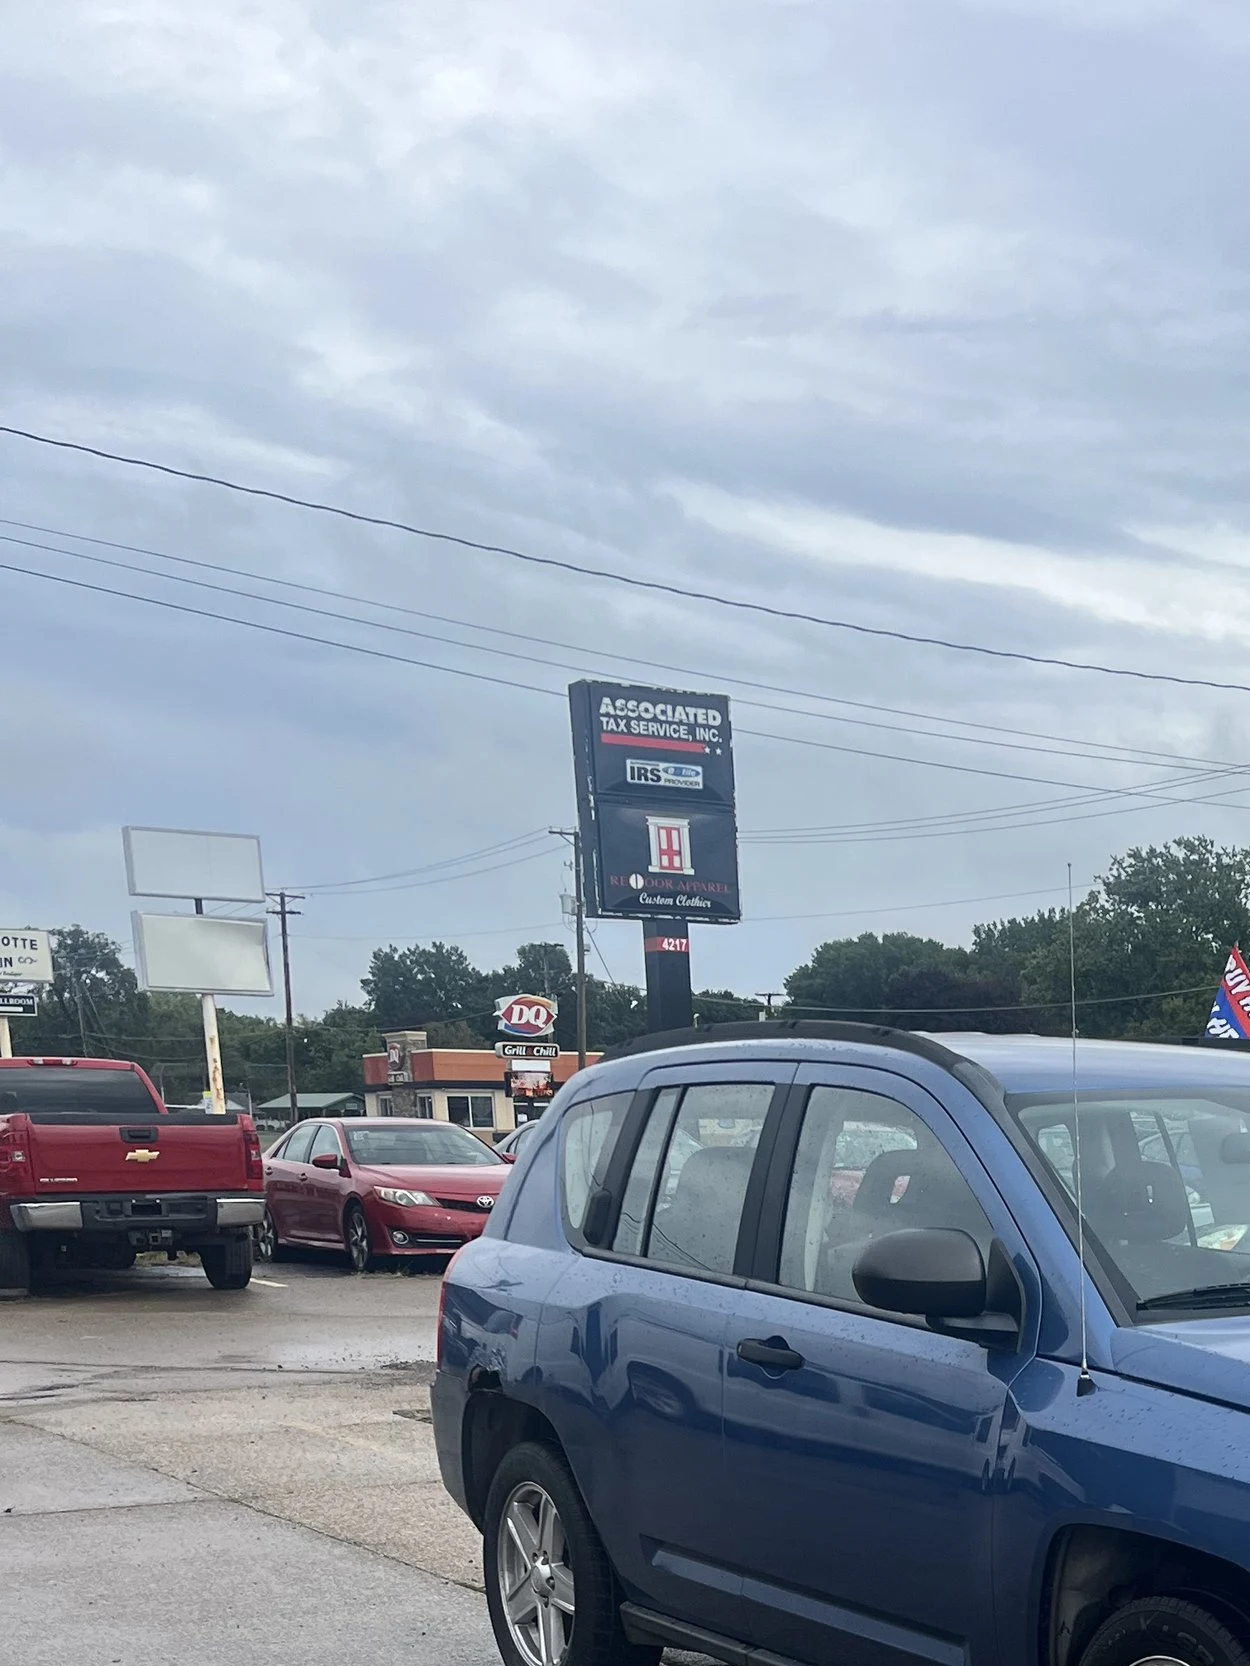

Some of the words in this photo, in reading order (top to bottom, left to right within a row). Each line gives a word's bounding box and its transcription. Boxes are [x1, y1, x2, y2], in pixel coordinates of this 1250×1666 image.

[599, 697, 722, 726] ASSOCIATED
[600, 716, 628, 733] TAX
[630, 719, 693, 742] SERVICE,
[696, 727, 723, 743] INC.
[630, 766, 662, 783] IRS
[664, 778, 700, 787] PROVIDER
[677, 880, 732, 894] APPAREL
[639, 892, 674, 906] Custom
[675, 894, 712, 908] Clothier
[662, 938, 688, 952] 4217
[510, 1004, 548, 1028] DQ
[504, 1045, 527, 1056] Grill
[533, 1046, 557, 1057] Chill
